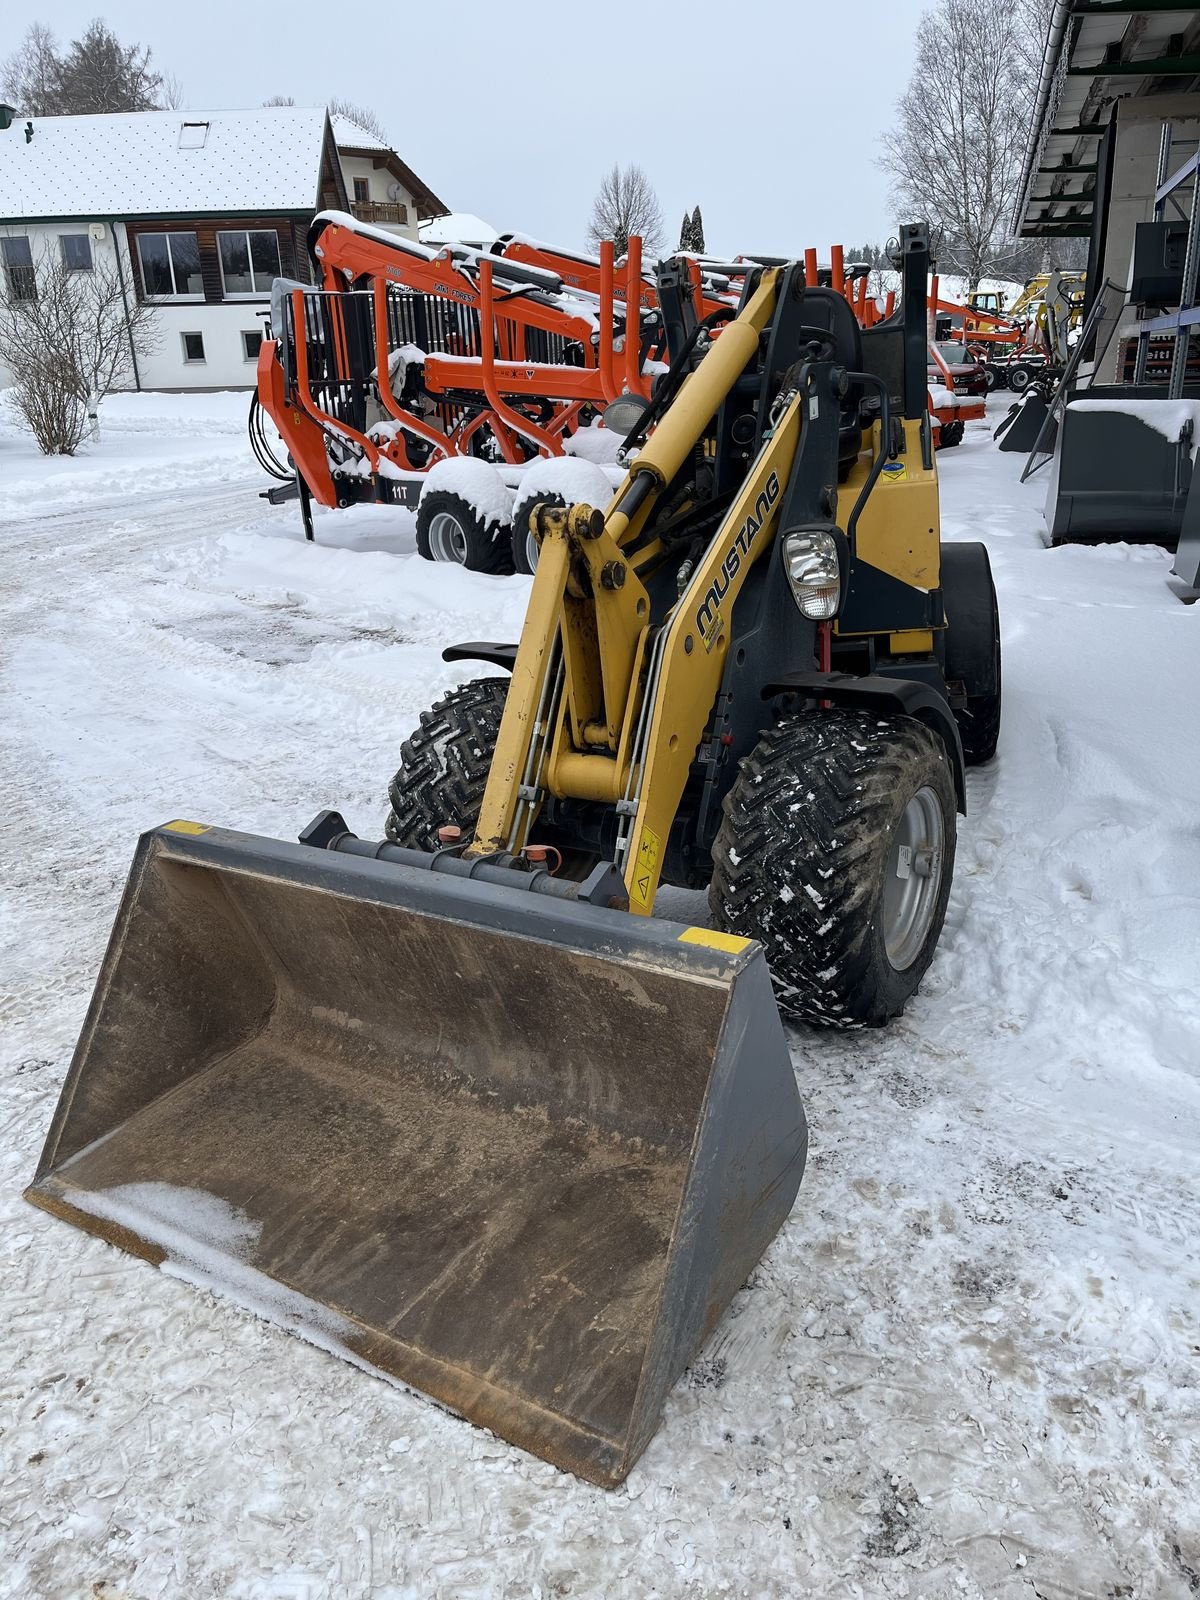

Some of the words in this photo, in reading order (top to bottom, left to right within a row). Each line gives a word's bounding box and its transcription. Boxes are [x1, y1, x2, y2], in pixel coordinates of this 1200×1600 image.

[451, 289, 476, 303] FOREST
[391, 485, 408, 499] 11T
[696, 471, 780, 639] MUSTANG
